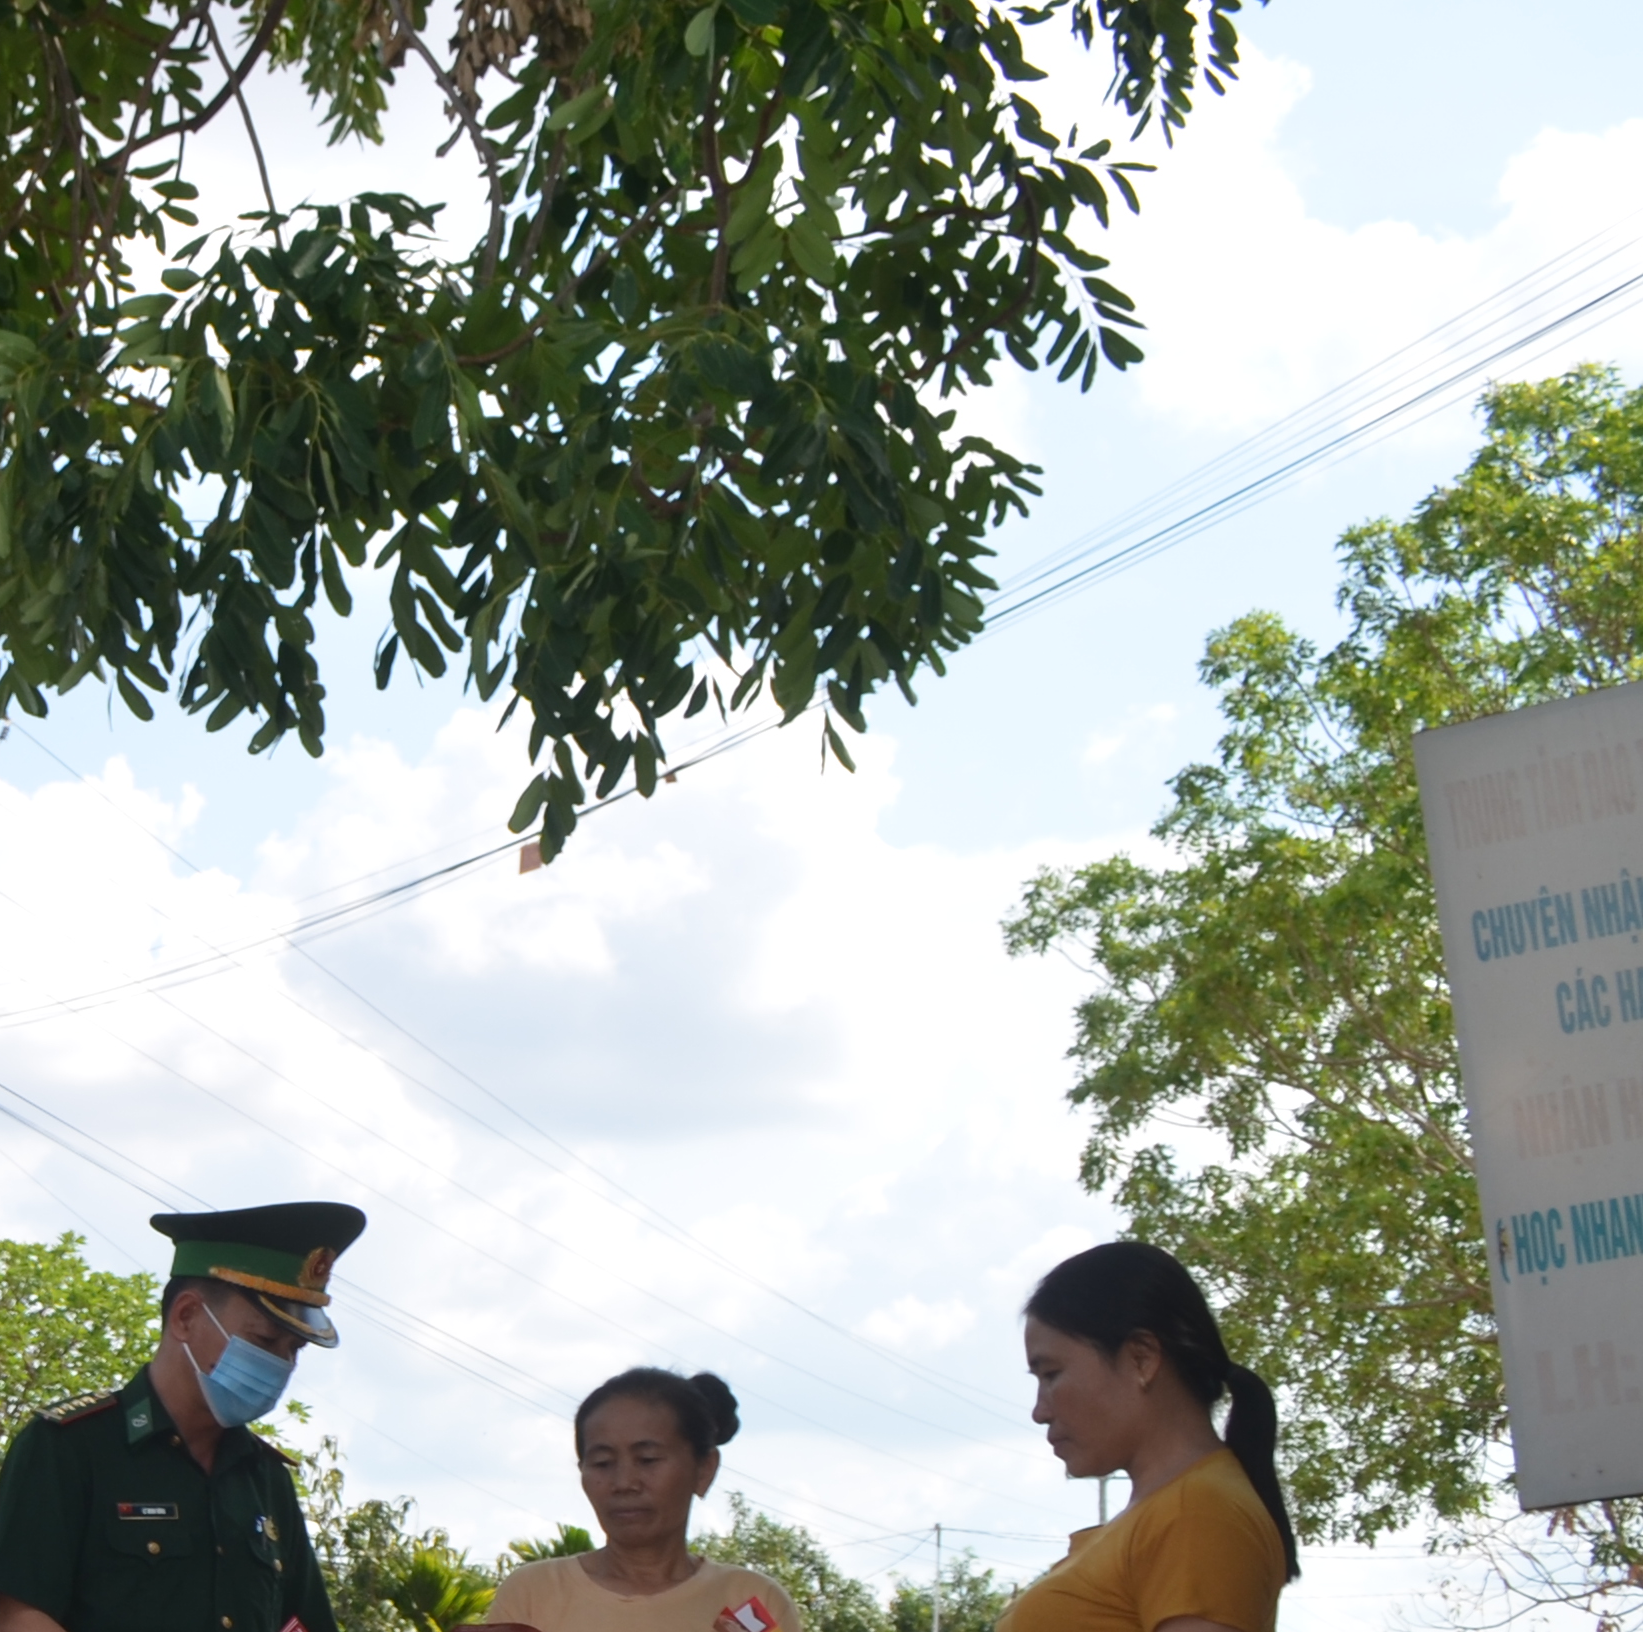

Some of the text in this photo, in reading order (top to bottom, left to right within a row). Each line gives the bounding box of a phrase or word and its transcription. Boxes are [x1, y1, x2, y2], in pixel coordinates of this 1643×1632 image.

[1472, 885, 1578, 963] CHUYÊN
[1555, 967, 1612, 1035] CÁC
[1513, 1074, 1613, 1165] NHẬN
